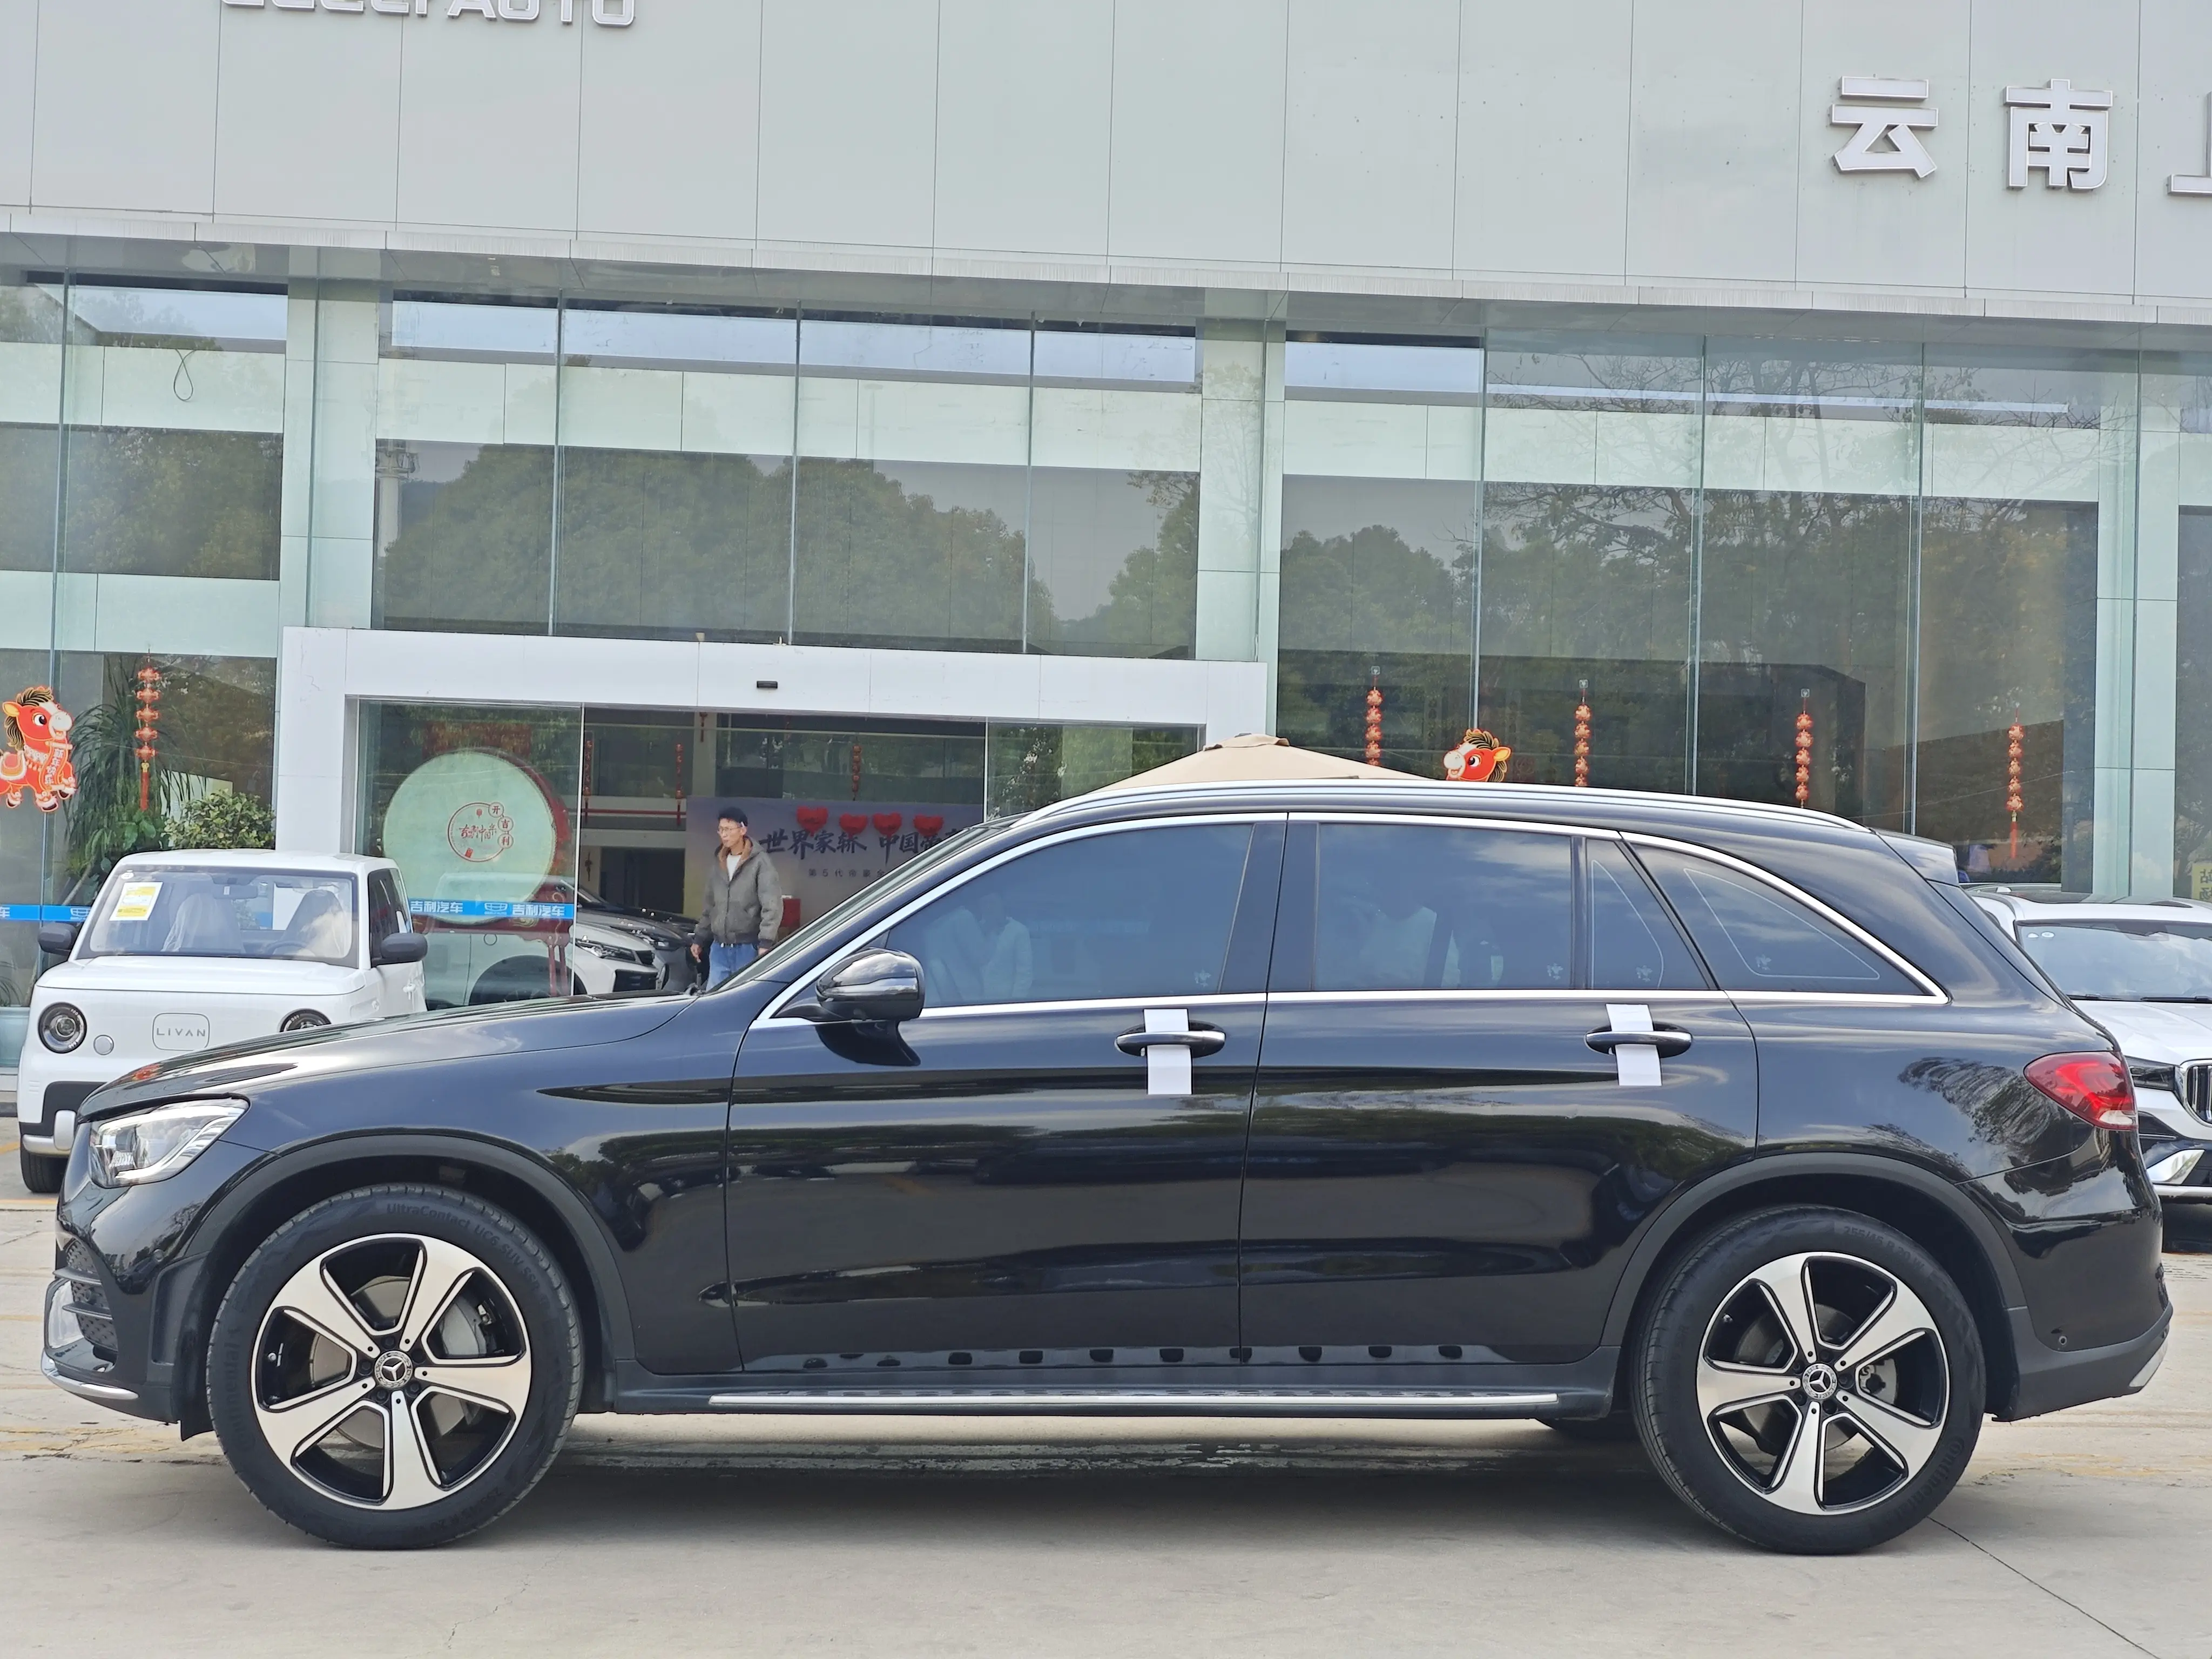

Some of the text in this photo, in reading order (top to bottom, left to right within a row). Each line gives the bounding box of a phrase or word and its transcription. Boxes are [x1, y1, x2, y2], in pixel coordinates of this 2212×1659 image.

[410, 900, 463, 913] 吉利汽车
[512, 903, 565, 917] 吉利汽车
